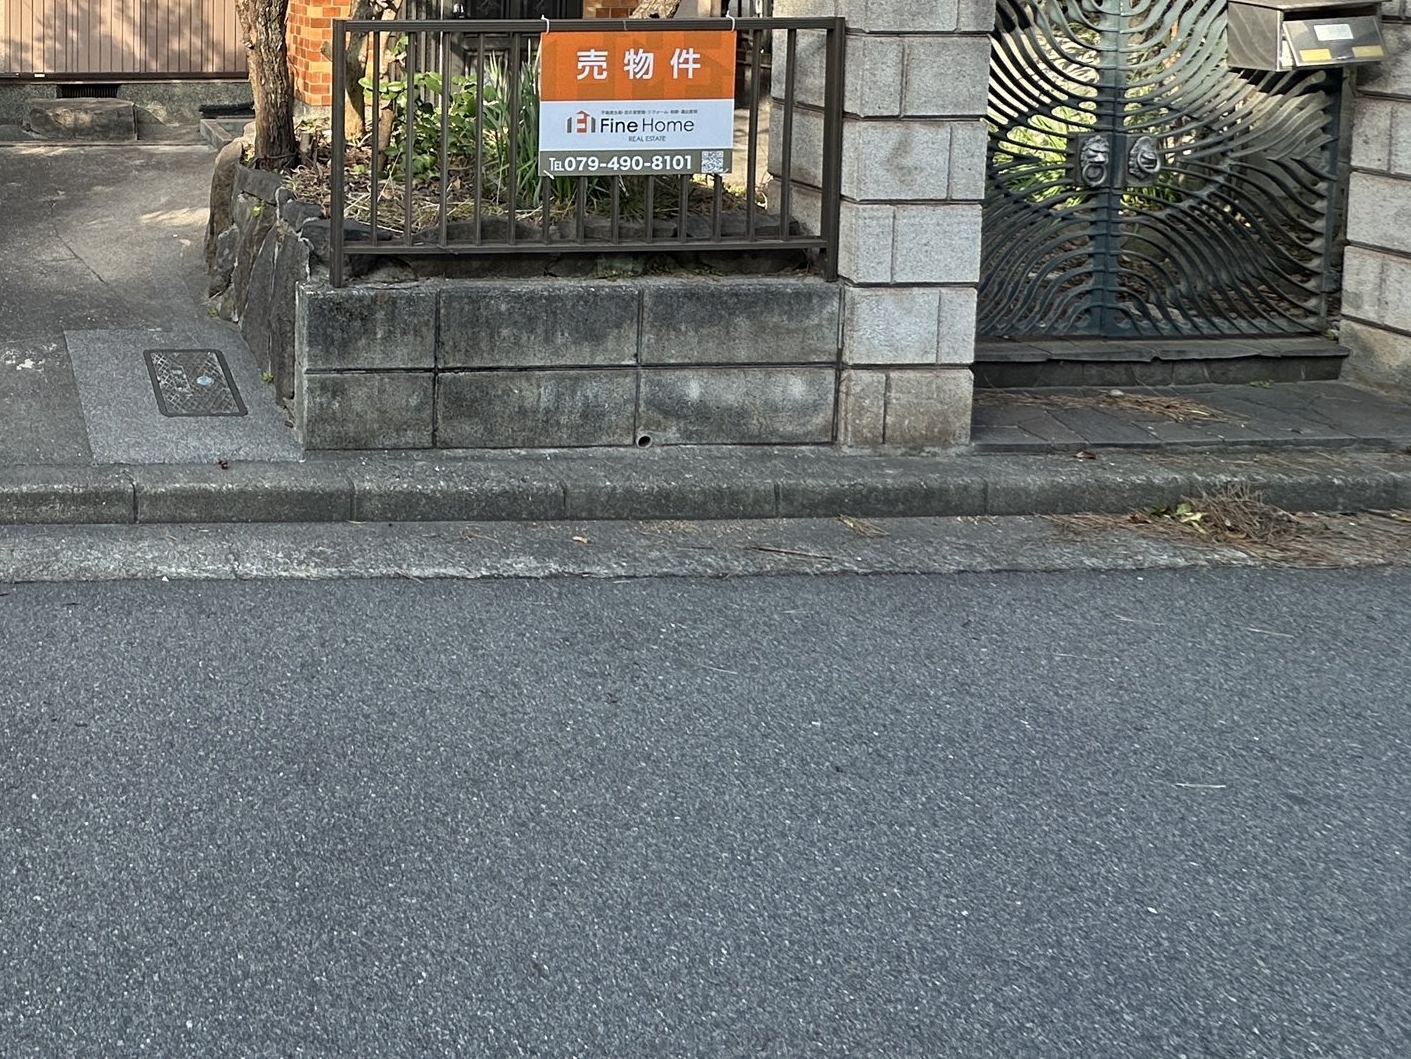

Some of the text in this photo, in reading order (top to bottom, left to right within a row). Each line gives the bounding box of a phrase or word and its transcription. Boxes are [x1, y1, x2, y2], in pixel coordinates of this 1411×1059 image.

[577, 48, 701, 80] 売物件
[600, 117, 695, 133] Fine Home
